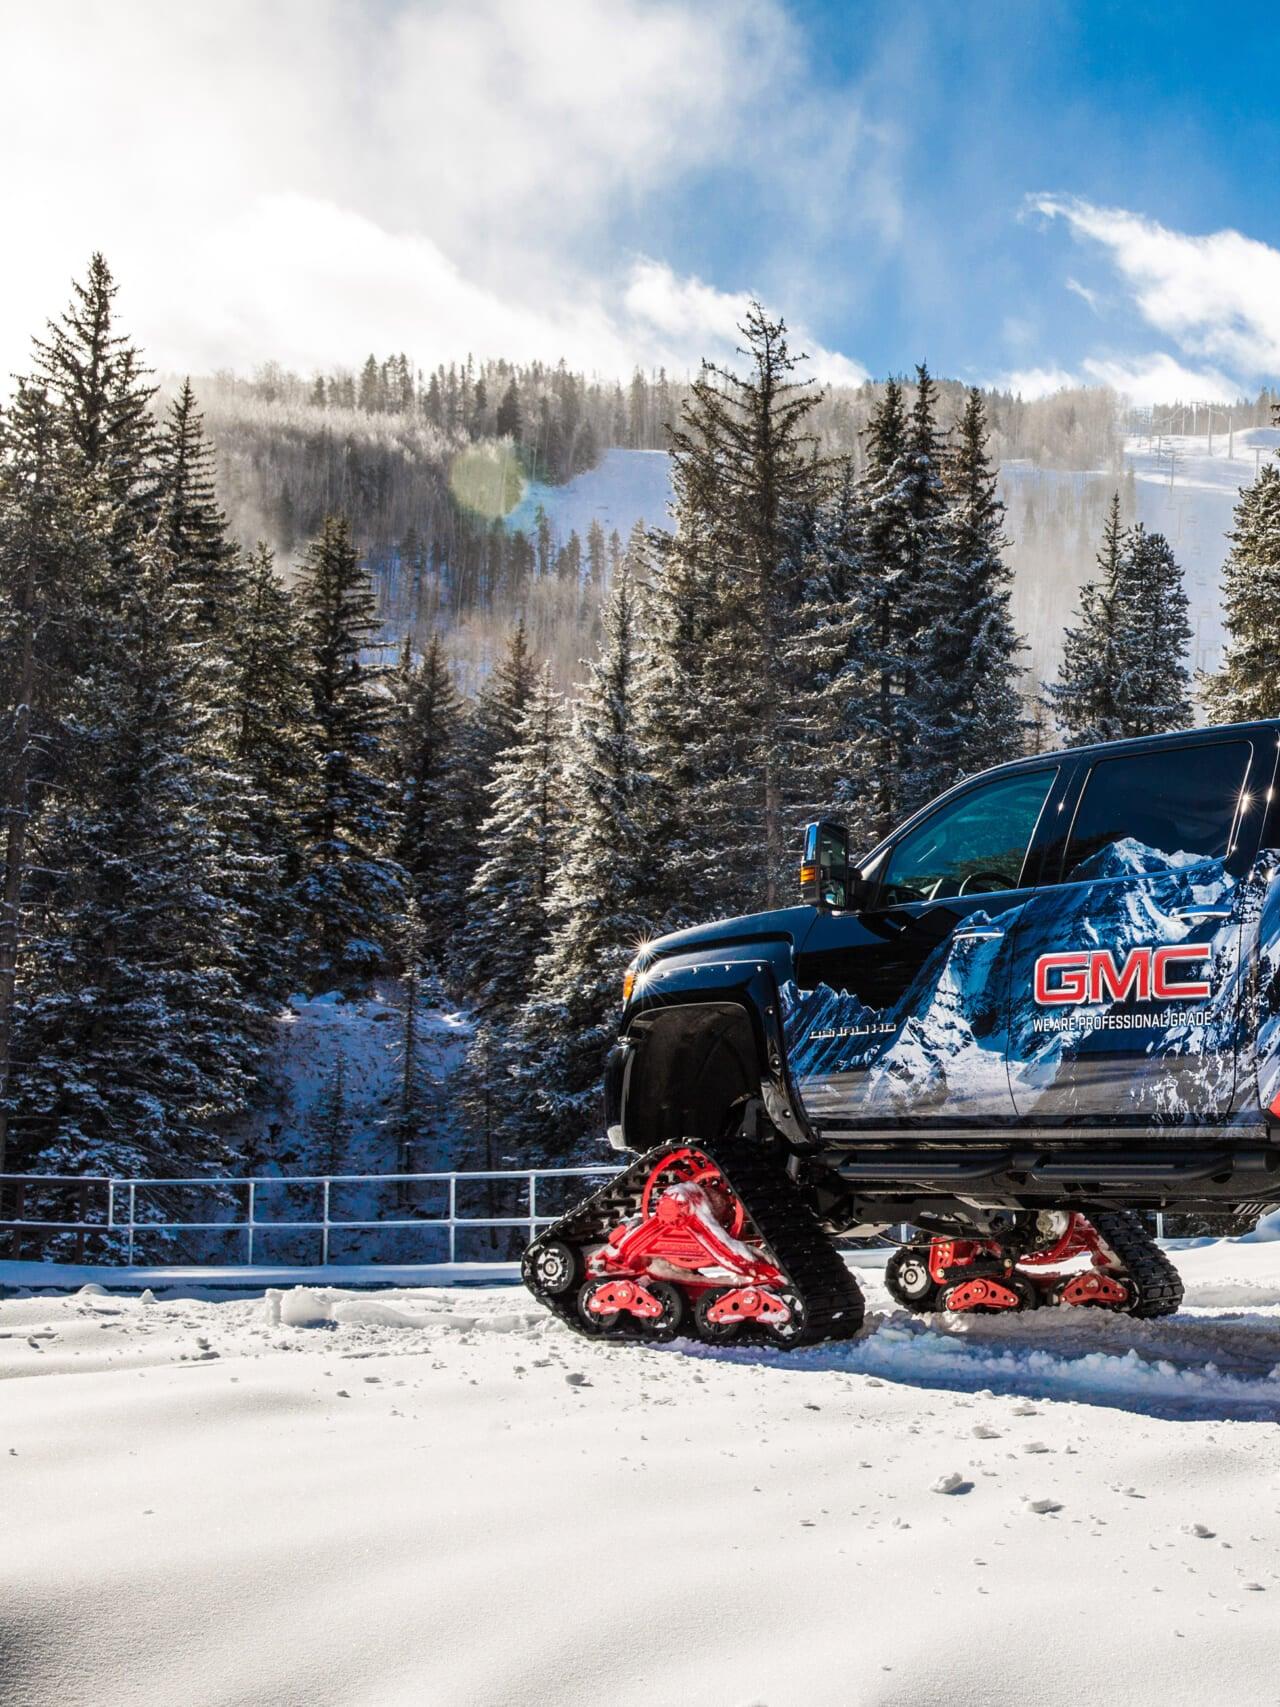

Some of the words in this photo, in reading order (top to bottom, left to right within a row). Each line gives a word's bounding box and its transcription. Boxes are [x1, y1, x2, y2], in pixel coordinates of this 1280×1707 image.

[1034, 943, 1212, 1005] GMC
[1033, 1019, 1050, 1032] WE
[1052, 1016, 1076, 1031] ARE
[1079, 1013, 1168, 1031] PROFESSIONAL
[1170, 1011, 1212, 1027] GRADE
